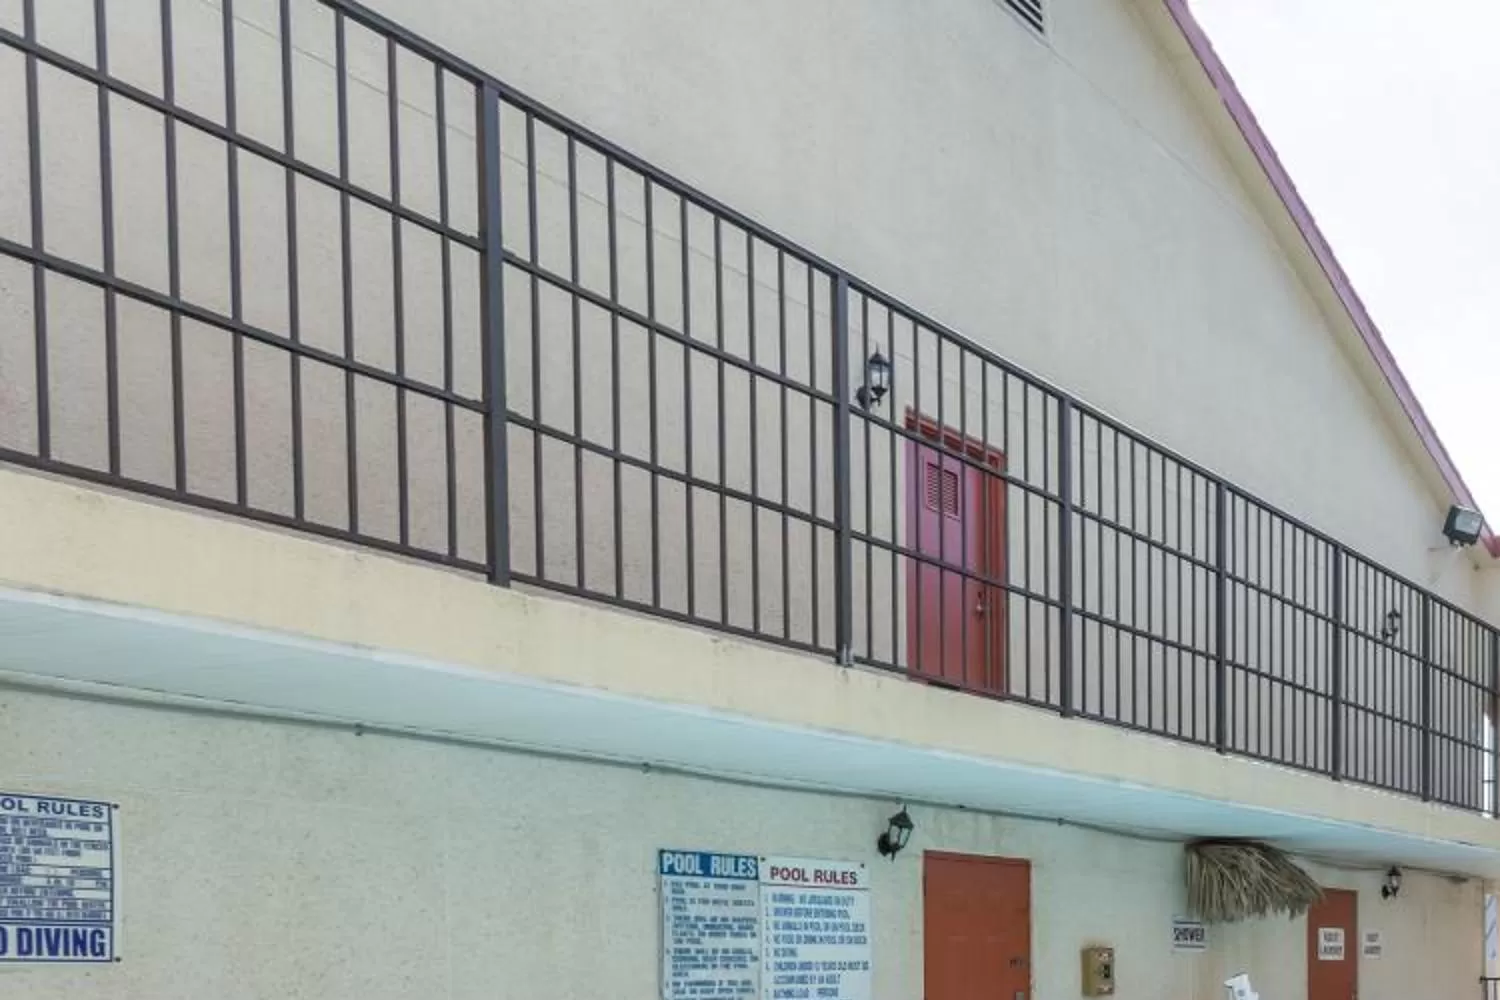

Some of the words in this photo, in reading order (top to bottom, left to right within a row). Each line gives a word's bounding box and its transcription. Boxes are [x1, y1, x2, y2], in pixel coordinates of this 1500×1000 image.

[37, 801, 104, 818] RULES
[663, 852, 703, 875] POOL
[710, 856, 758, 878] RULES
[770, 866, 809, 882] POOL
[814, 870, 858, 885] RULES
[16, 927, 106, 957] DIVING
